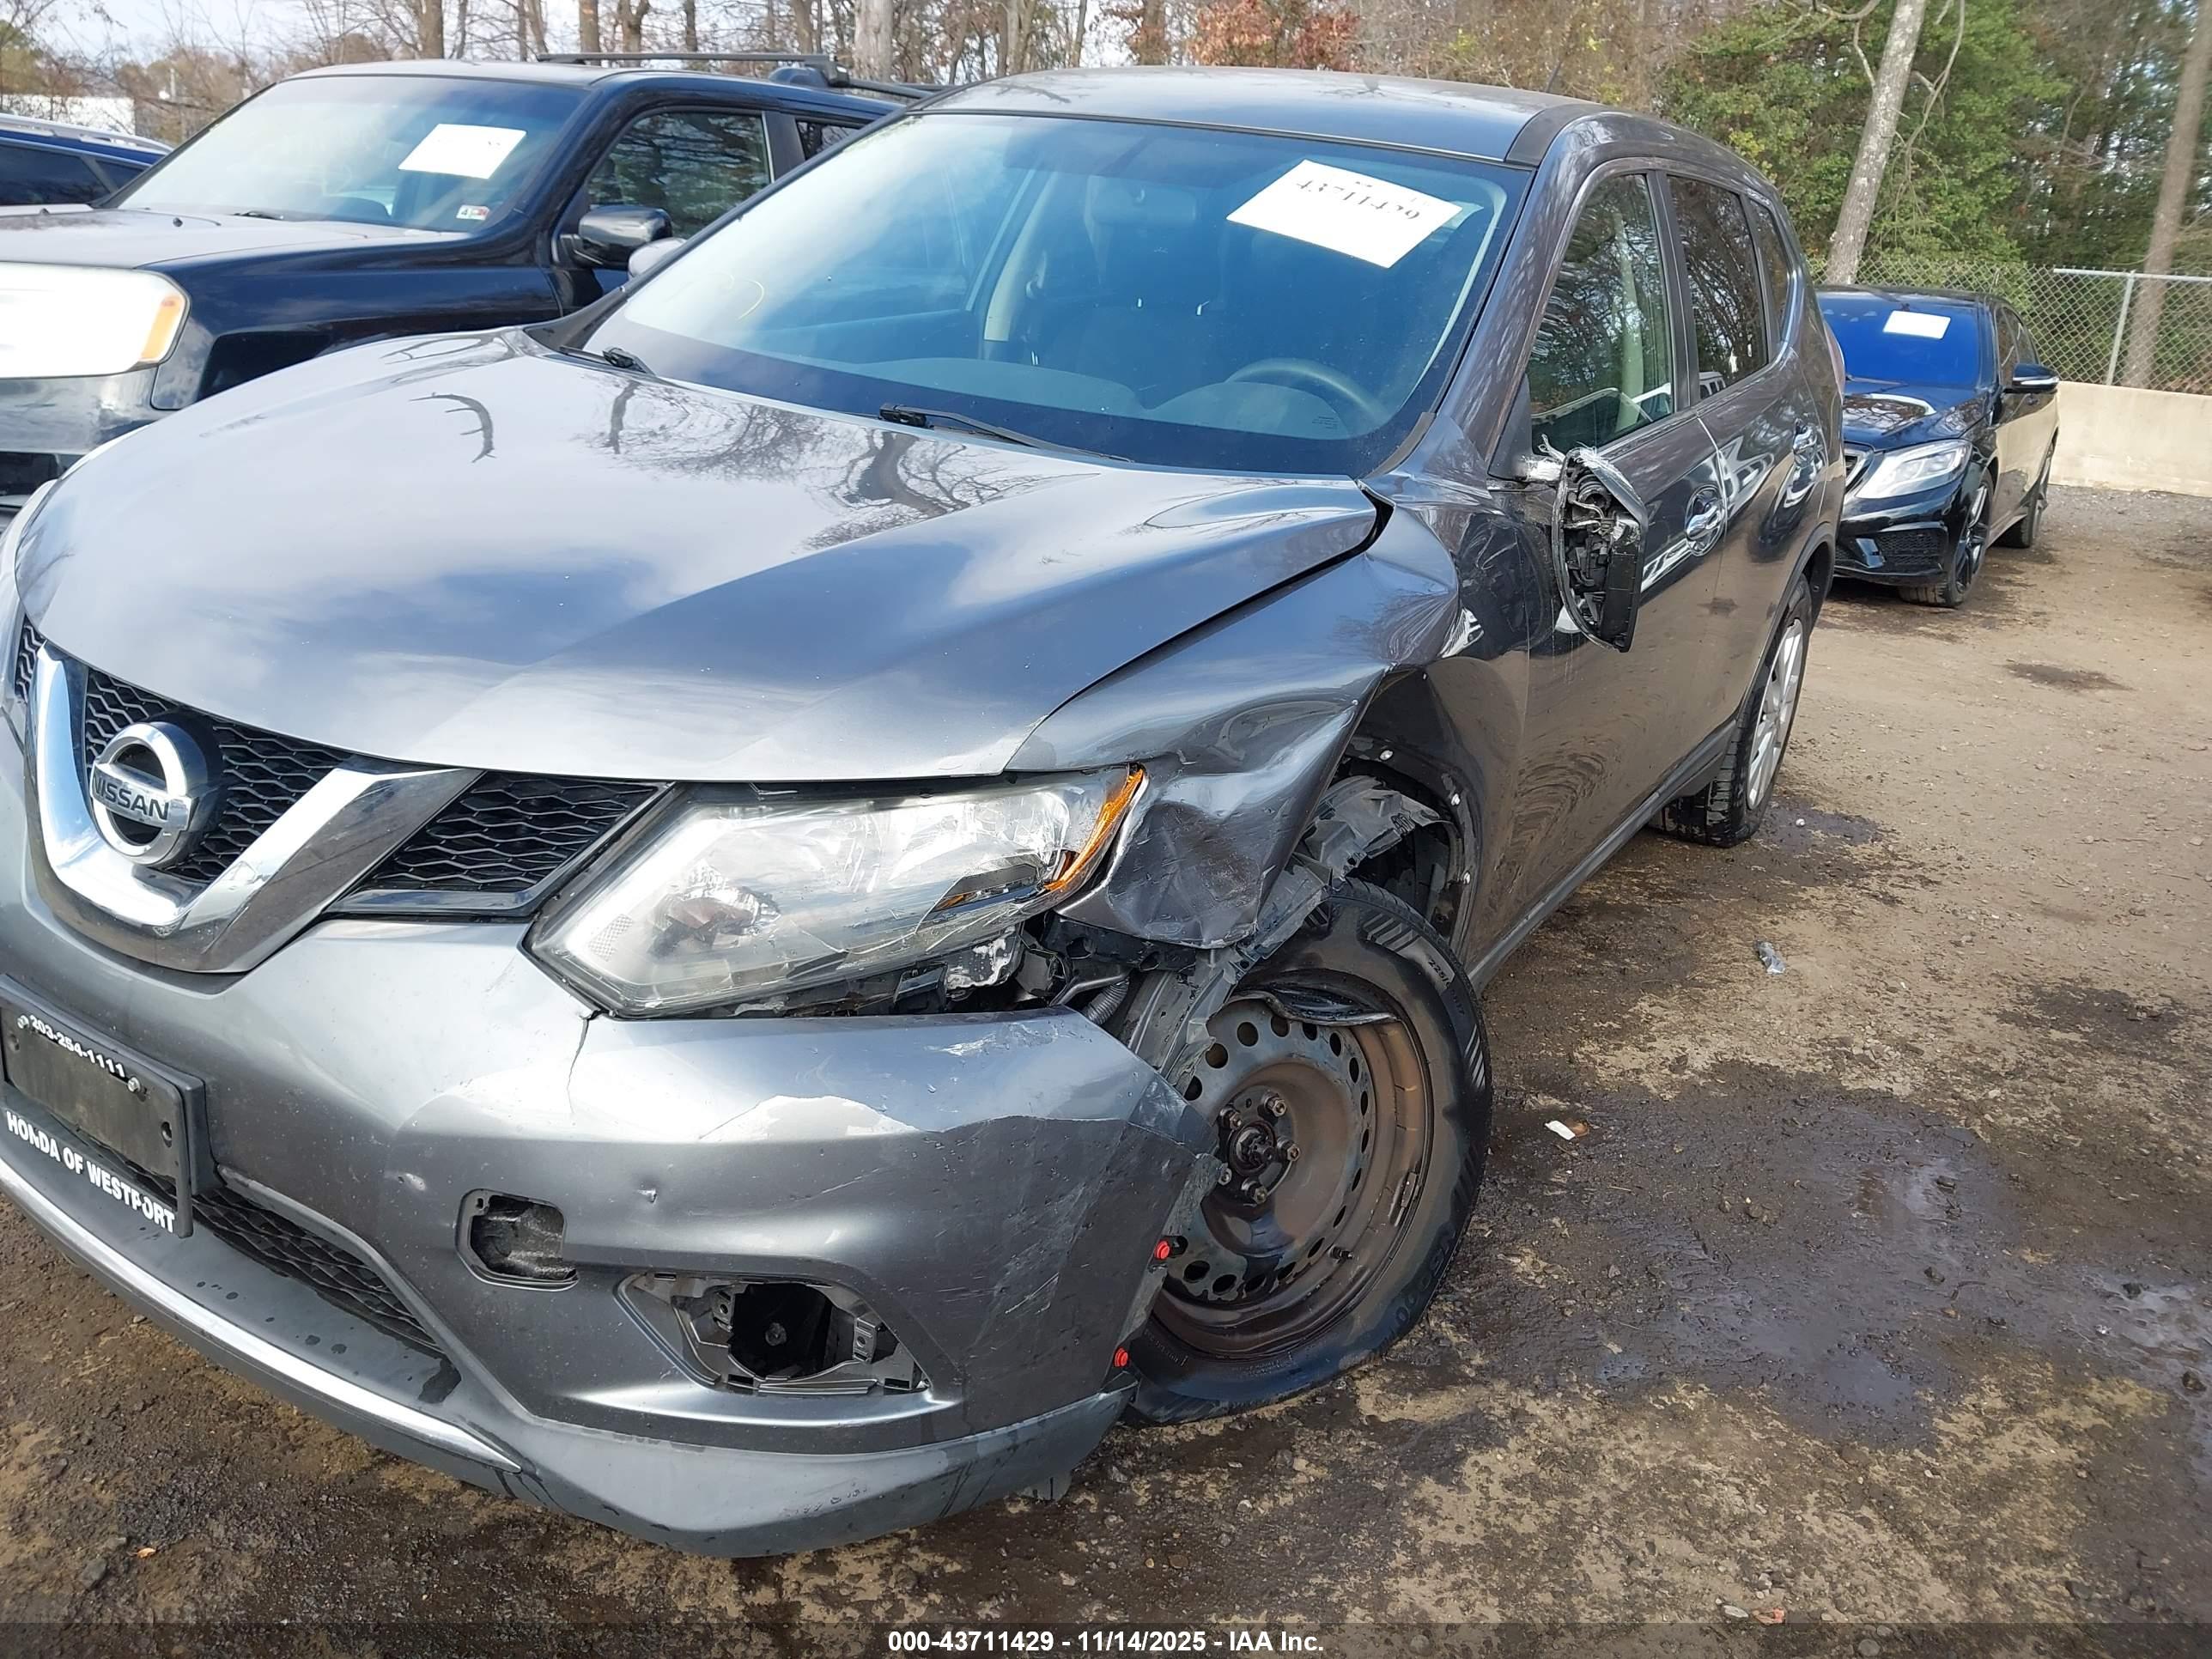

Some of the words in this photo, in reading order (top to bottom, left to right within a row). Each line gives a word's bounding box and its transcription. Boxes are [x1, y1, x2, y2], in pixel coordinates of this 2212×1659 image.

[93, 774, 170, 821] NISSAN
[29, 1014, 126, 1079] 203-254-1111
[7, 1111, 62, 1163] HONDA
[63, 1146, 84, 1175] OF
[86, 1160, 176, 1234] WESTPORT
